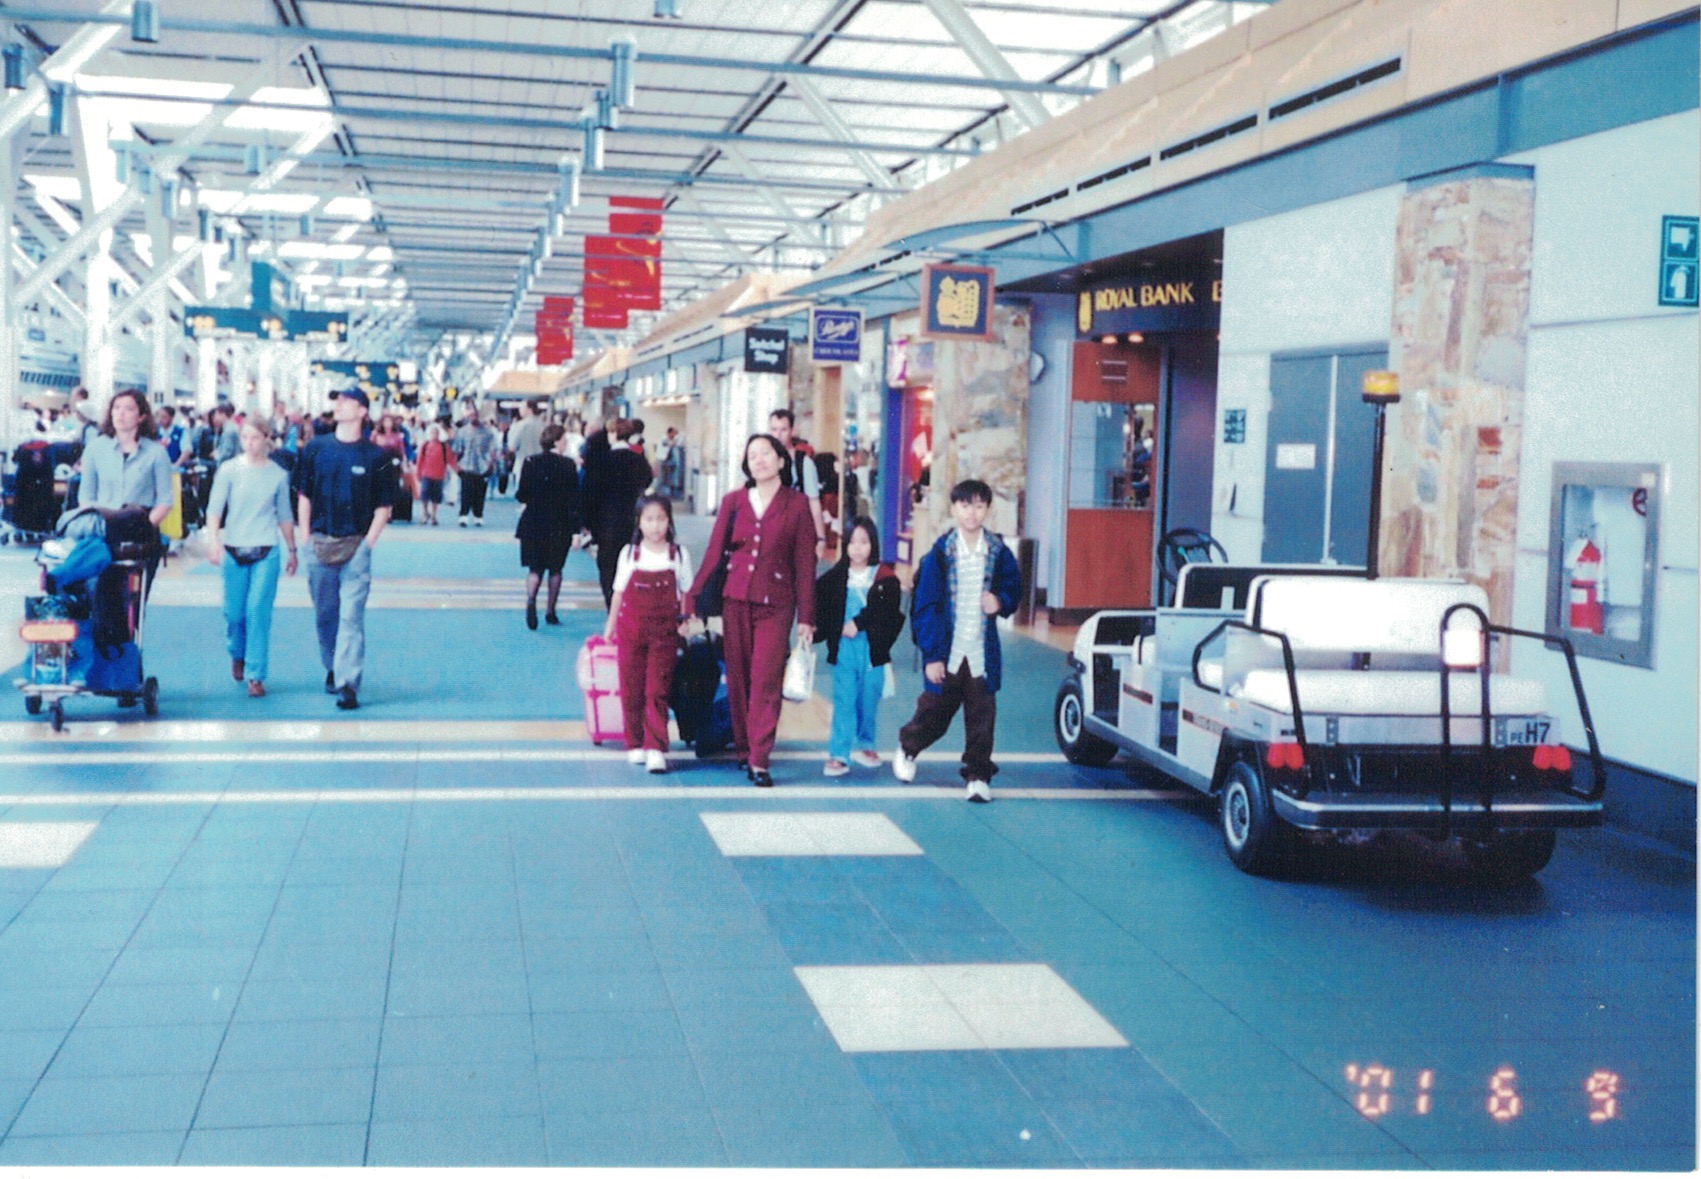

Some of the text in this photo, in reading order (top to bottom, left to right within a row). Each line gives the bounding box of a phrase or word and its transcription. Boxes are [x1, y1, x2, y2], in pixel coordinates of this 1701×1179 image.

[1095, 287, 1138, 311] ROYAL
[1141, 282, 1194, 307] BANK
[1525, 722, 1551, 743] H7
